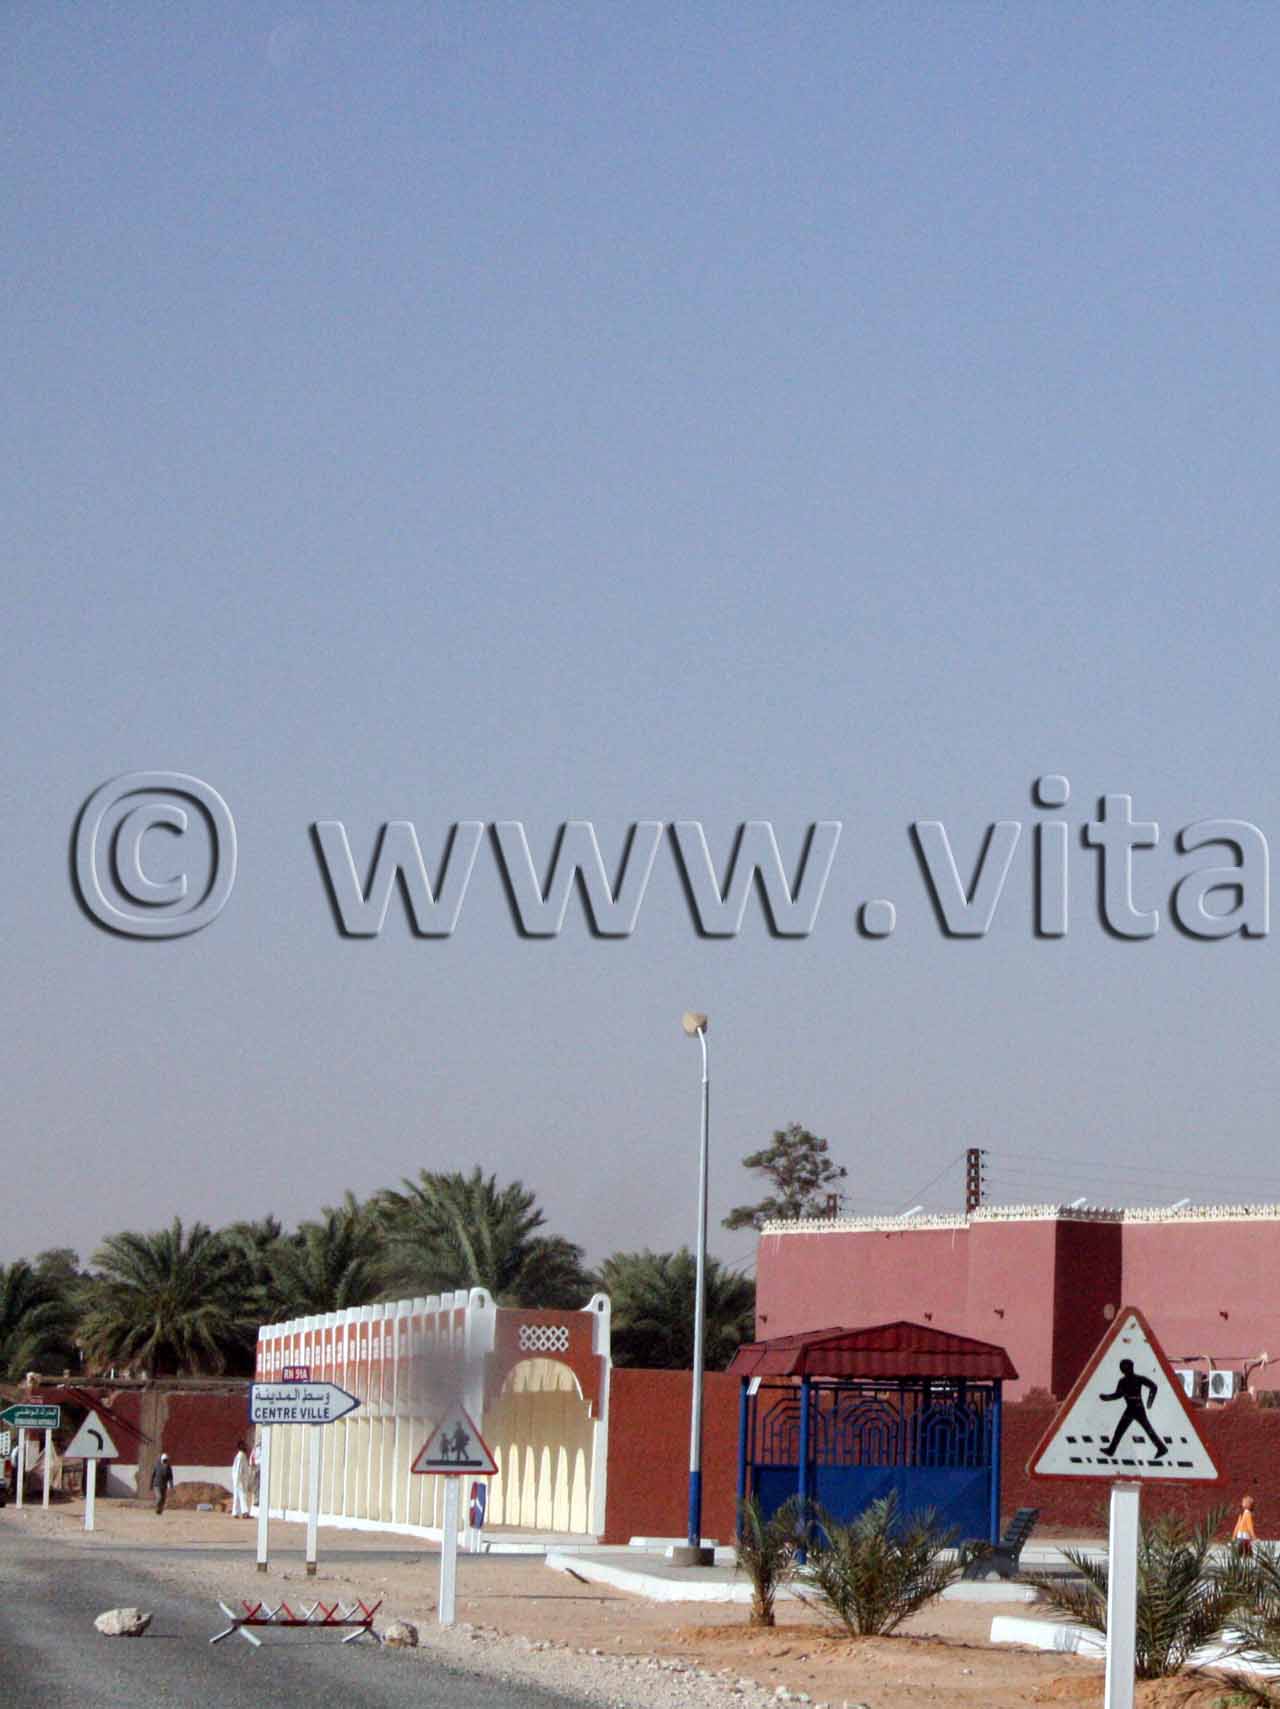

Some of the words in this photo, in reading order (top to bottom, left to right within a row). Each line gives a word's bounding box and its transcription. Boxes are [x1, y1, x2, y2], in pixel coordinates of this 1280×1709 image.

[254, 1388, 301, 1405] المدينة
[302, 1388, 330, 1405] وسط
[254, 1408, 297, 1418] CENTRE
[300, 1408, 330, 1418] VILLE
